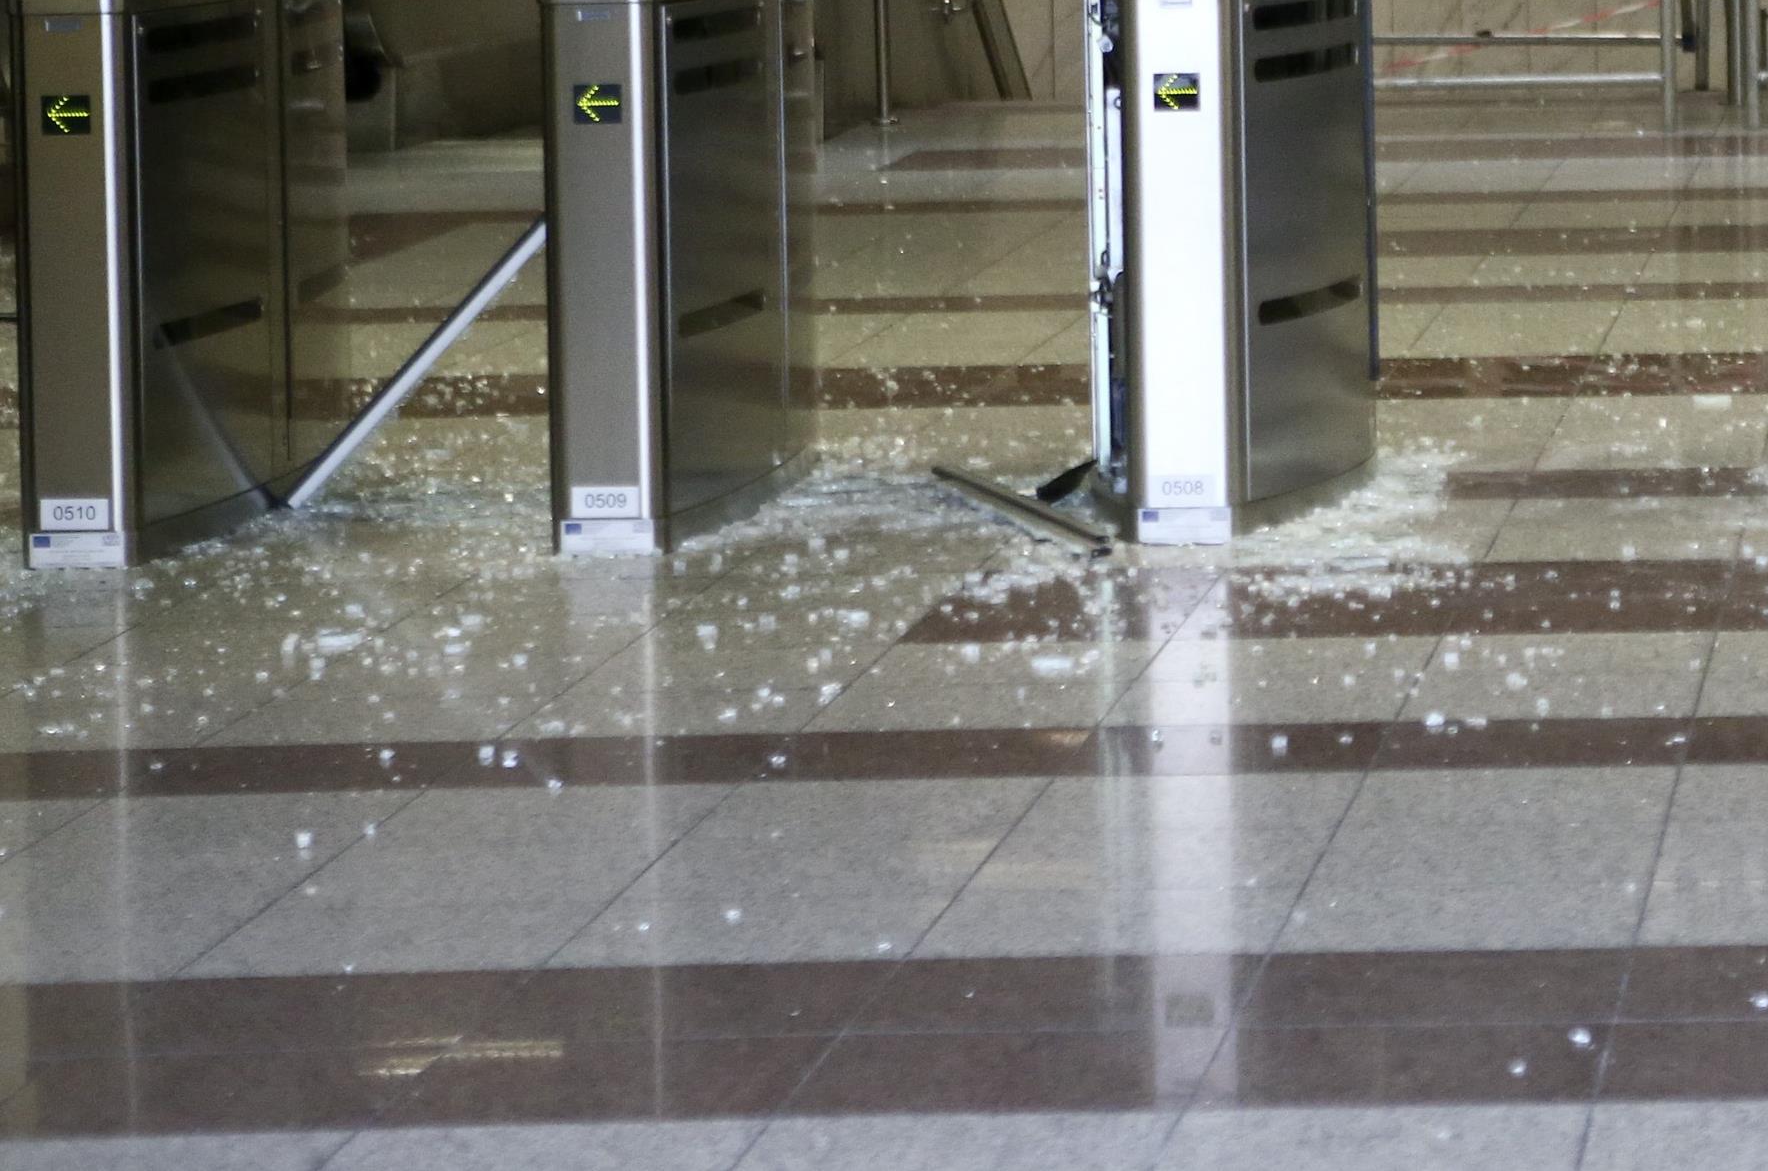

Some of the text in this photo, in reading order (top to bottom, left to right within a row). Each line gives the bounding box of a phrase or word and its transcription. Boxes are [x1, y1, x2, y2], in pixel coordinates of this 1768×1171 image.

[1161, 480, 1205, 496] 0508
[584, 493, 627, 509] 0509
[52, 505, 97, 521] 0510
